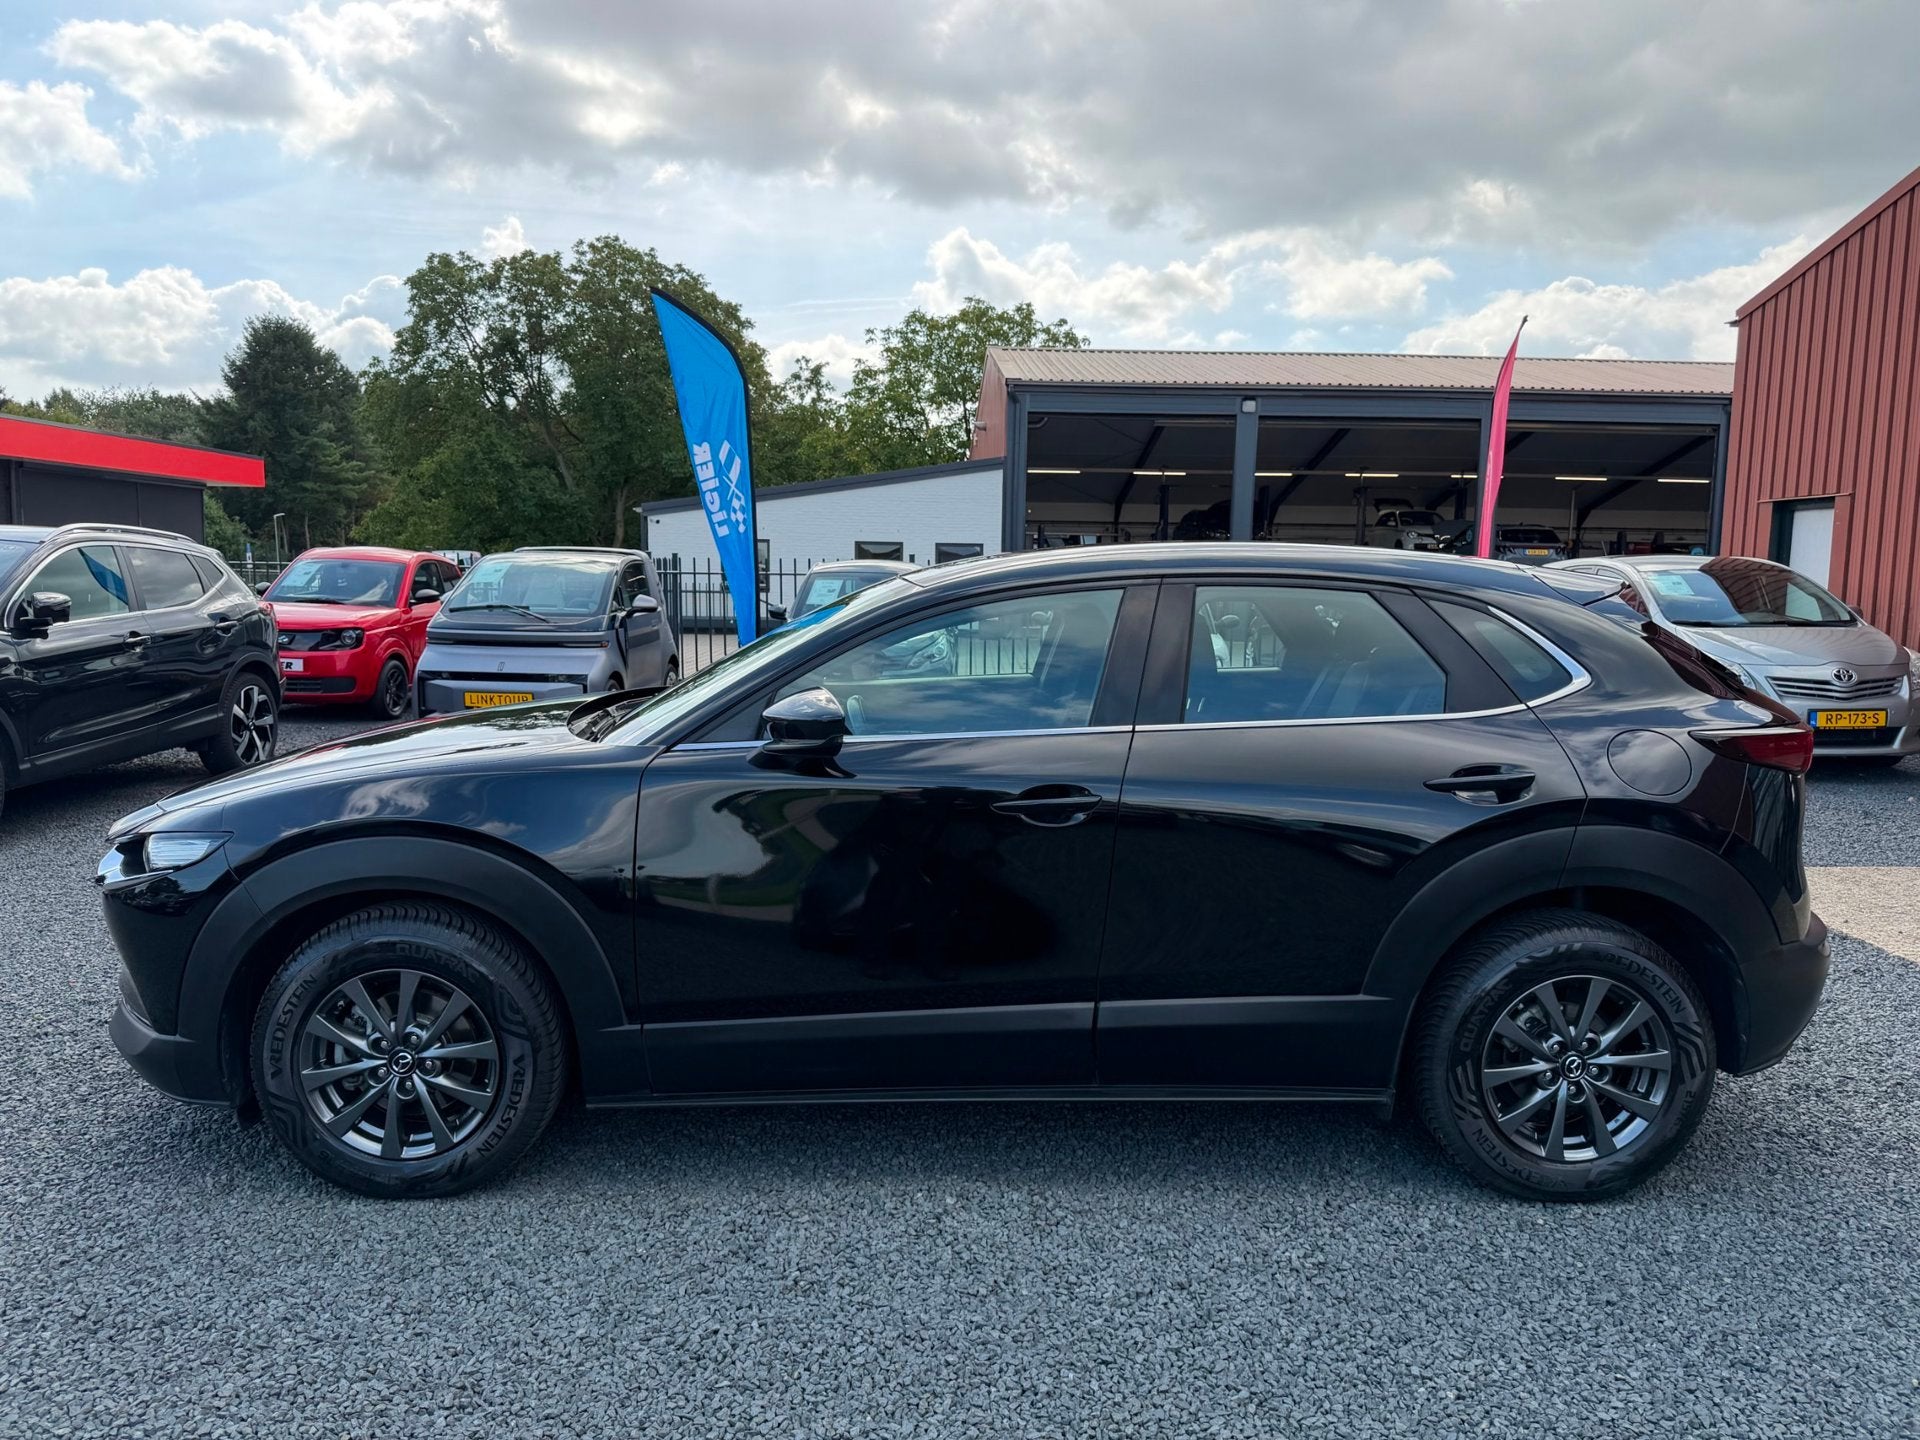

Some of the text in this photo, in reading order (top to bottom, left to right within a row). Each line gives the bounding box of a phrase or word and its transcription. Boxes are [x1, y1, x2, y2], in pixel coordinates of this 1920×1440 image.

[1825, 712, 1880, 725] RP-173-S
[396, 943, 480, 983] QUATRAC
[1595, 950, 1686, 1015] VREDESTEIN
[269, 974, 318, 1080] VREDESTEIN
[1459, 978, 1511, 1052] QUATRAC
[476, 1053, 528, 1159] VREDESTEIN
